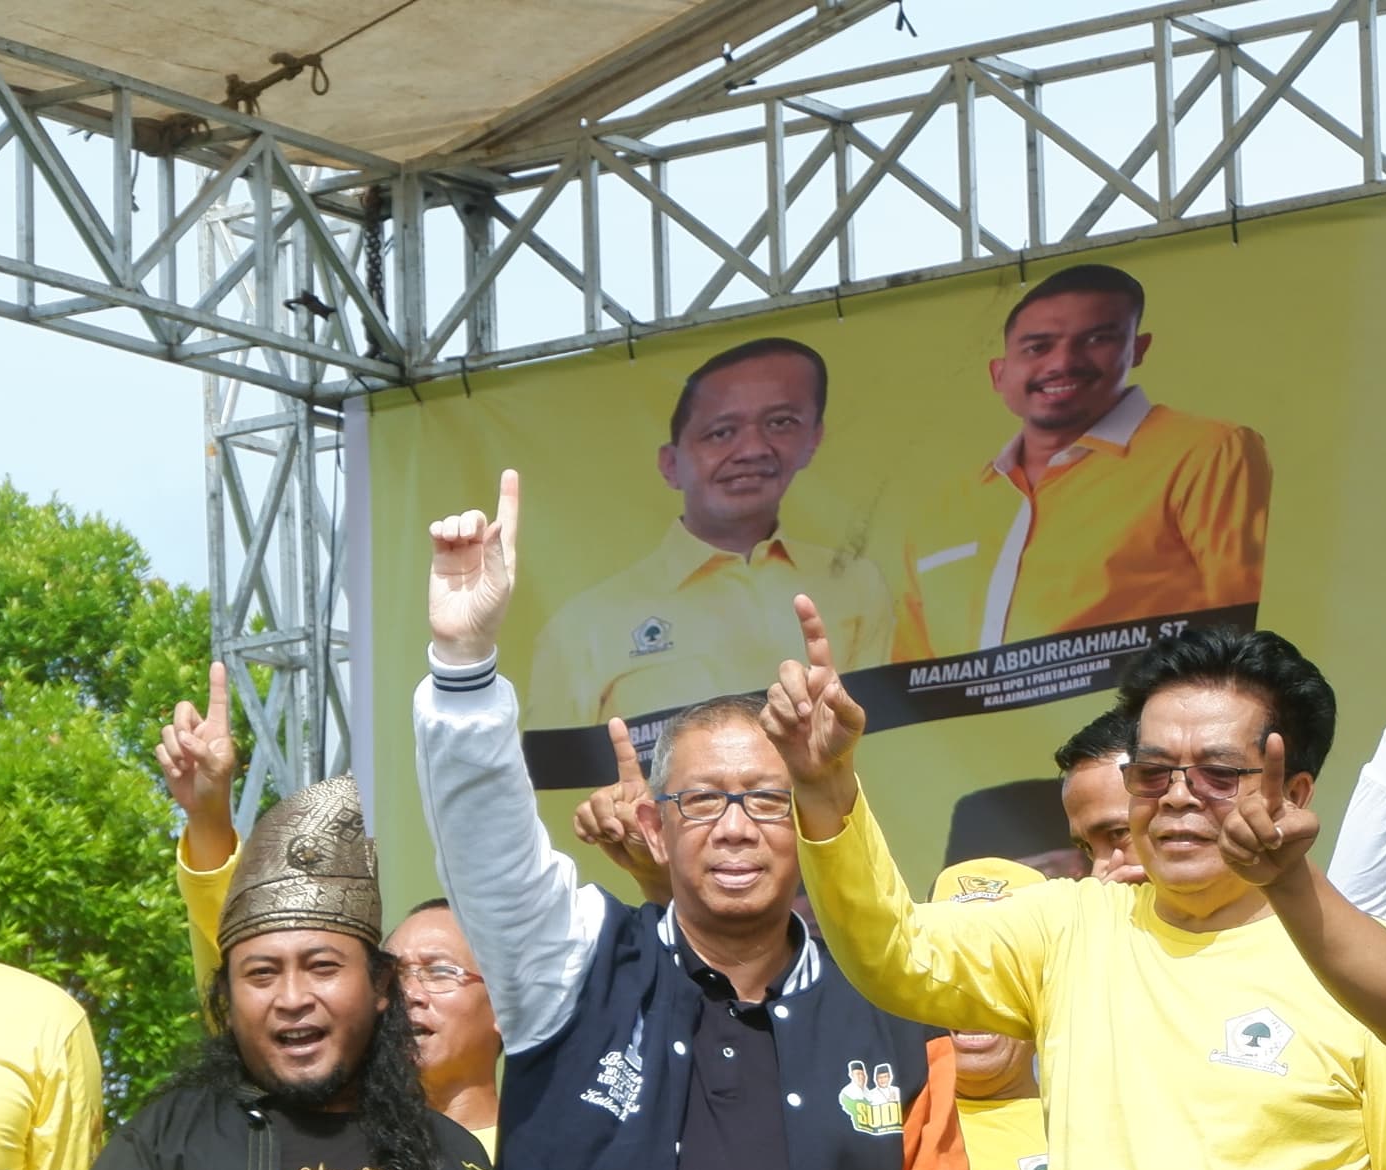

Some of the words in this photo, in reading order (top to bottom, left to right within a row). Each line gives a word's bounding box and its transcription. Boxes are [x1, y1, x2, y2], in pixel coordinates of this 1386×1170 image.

[909, 655, 989, 686] MAMAN
[993, 626, 1152, 675] ABDURRAHMAN,
[1069, 659, 1110, 677] GOLKAR
